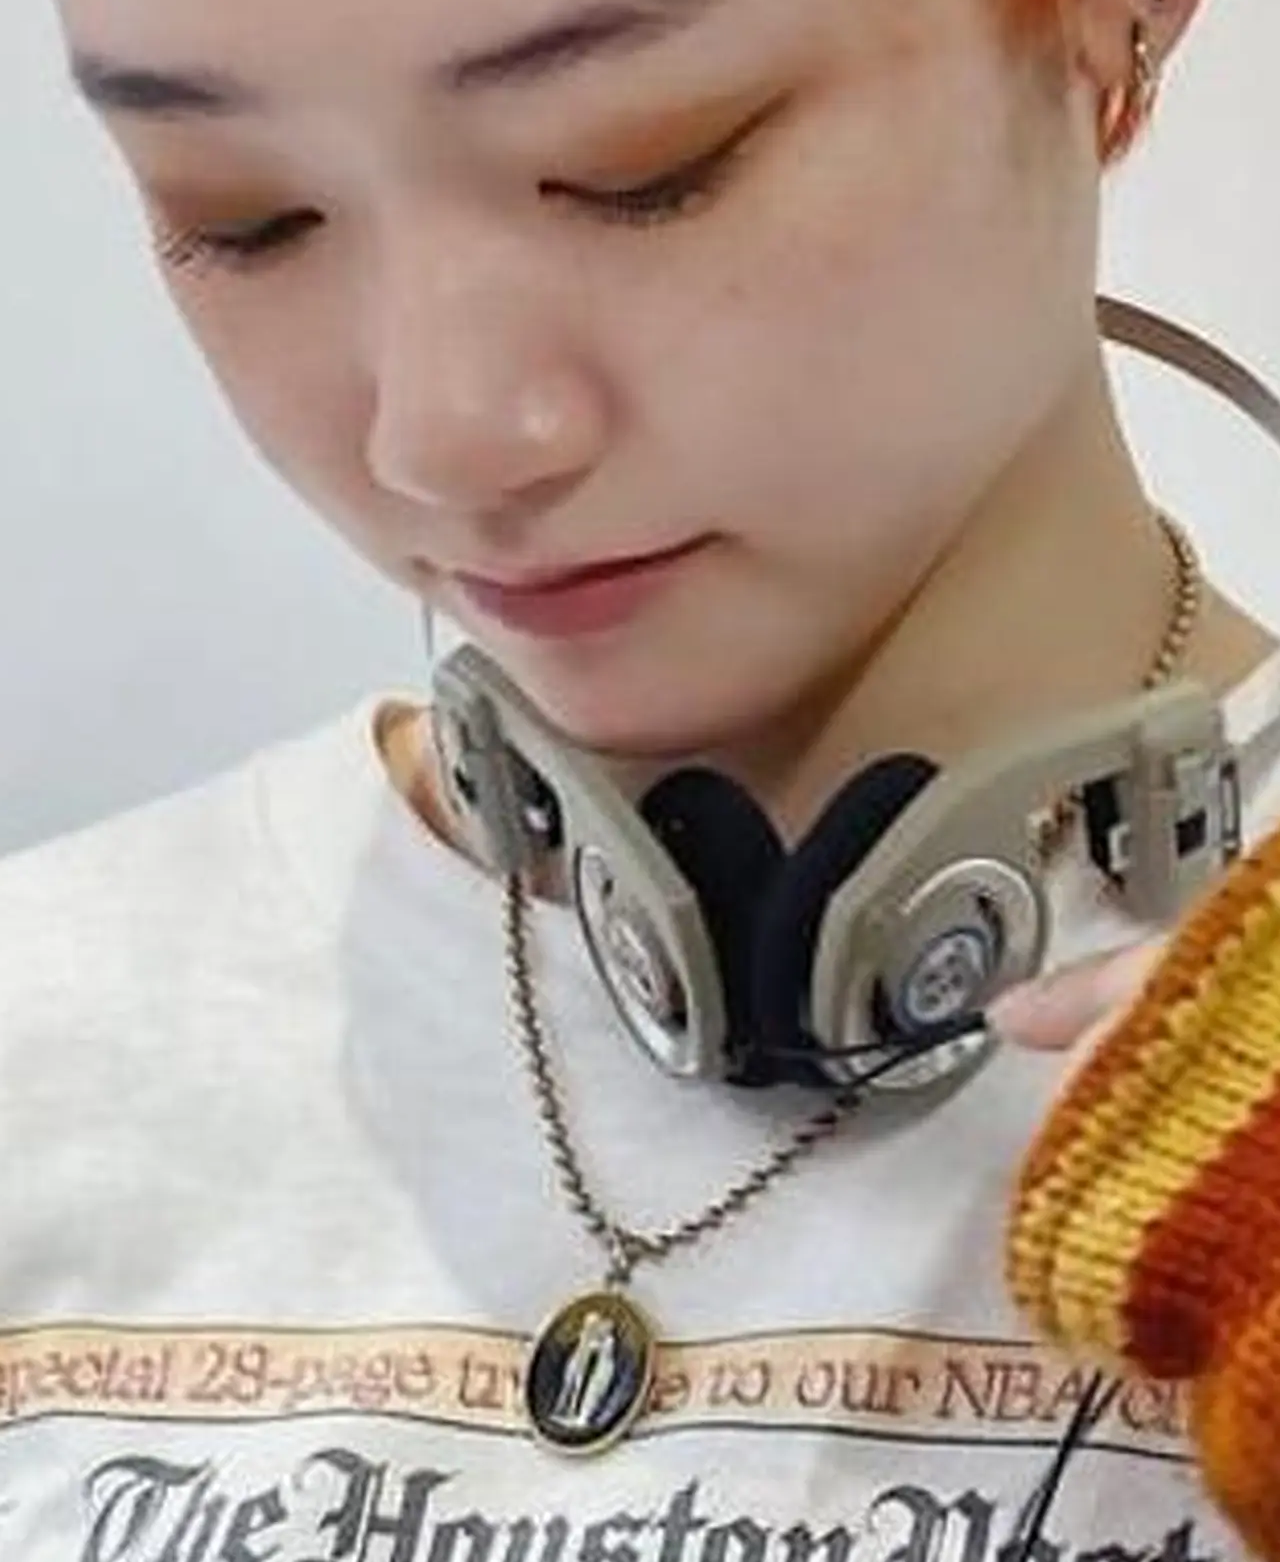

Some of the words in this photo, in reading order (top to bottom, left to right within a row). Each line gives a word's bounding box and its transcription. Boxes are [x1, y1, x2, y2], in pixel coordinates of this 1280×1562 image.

[186, 1341, 434, 1411] 28-page
[706, 1357, 769, 1409] to
[797, 1358, 922, 1416] our
[932, 1356, 1108, 1424] NBA
